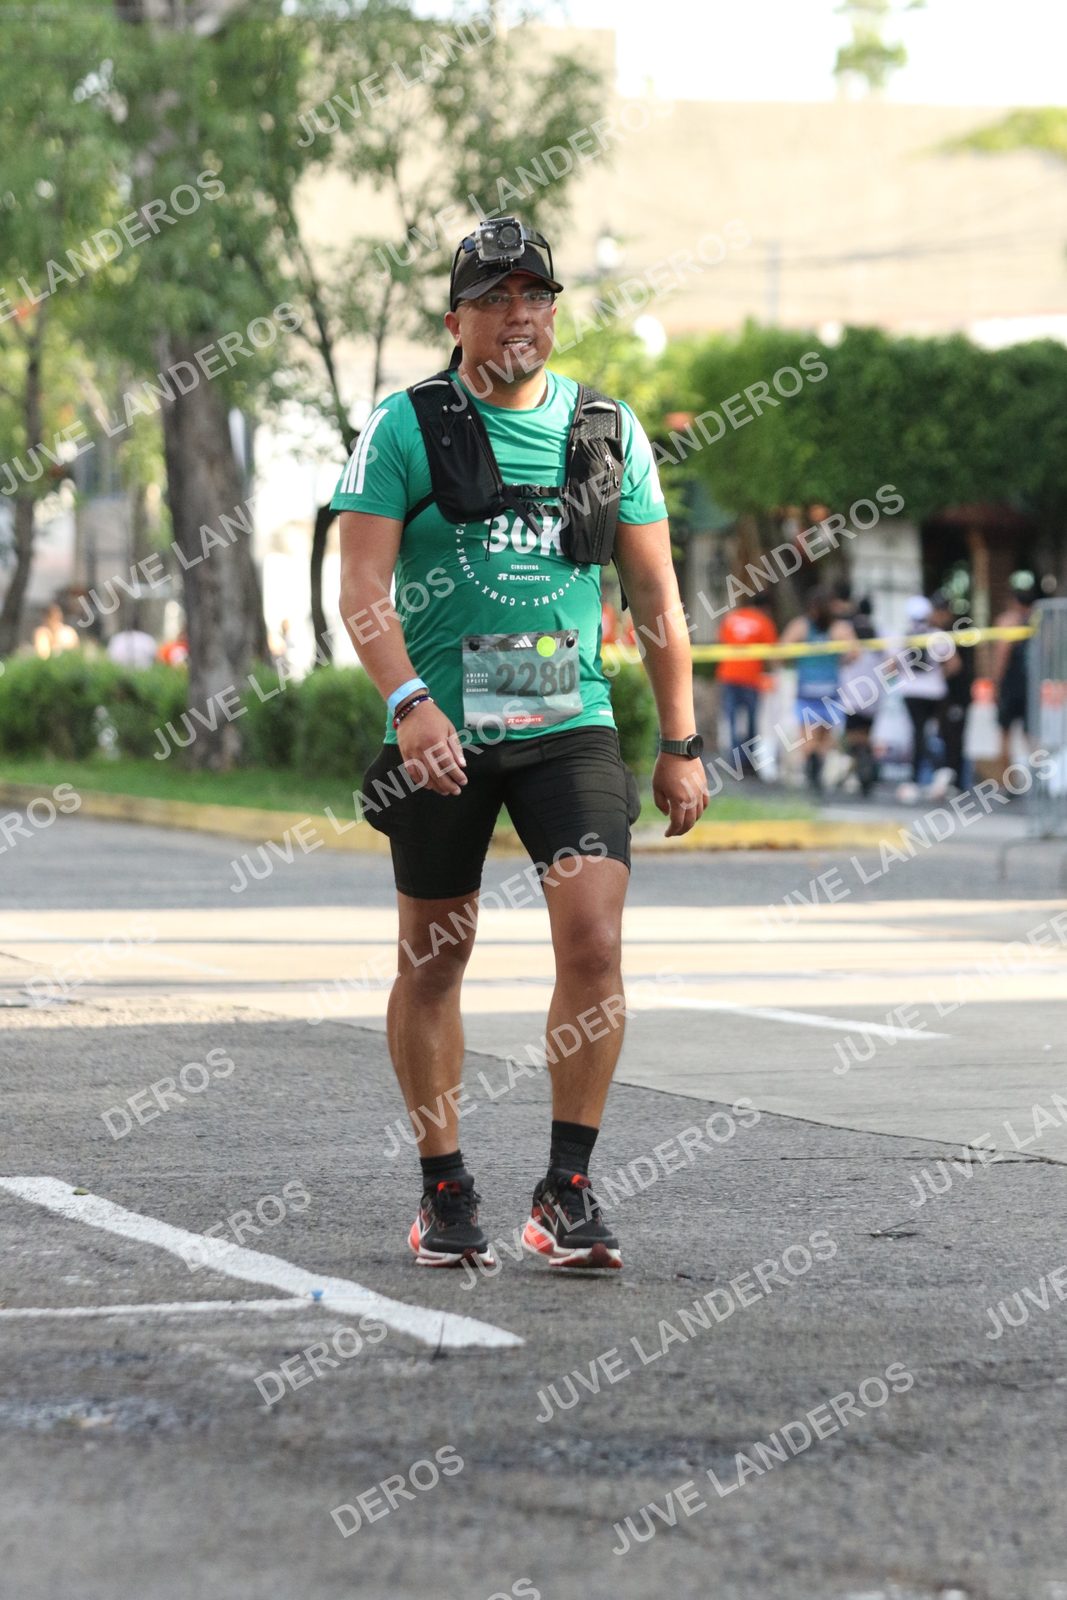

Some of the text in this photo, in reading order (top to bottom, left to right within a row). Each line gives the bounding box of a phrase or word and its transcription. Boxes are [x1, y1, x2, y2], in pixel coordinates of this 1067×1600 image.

[482, 514, 565, 556] 30K
[509, 574, 551, 582] BANORTE
[495, 660, 576, 697] 2280
